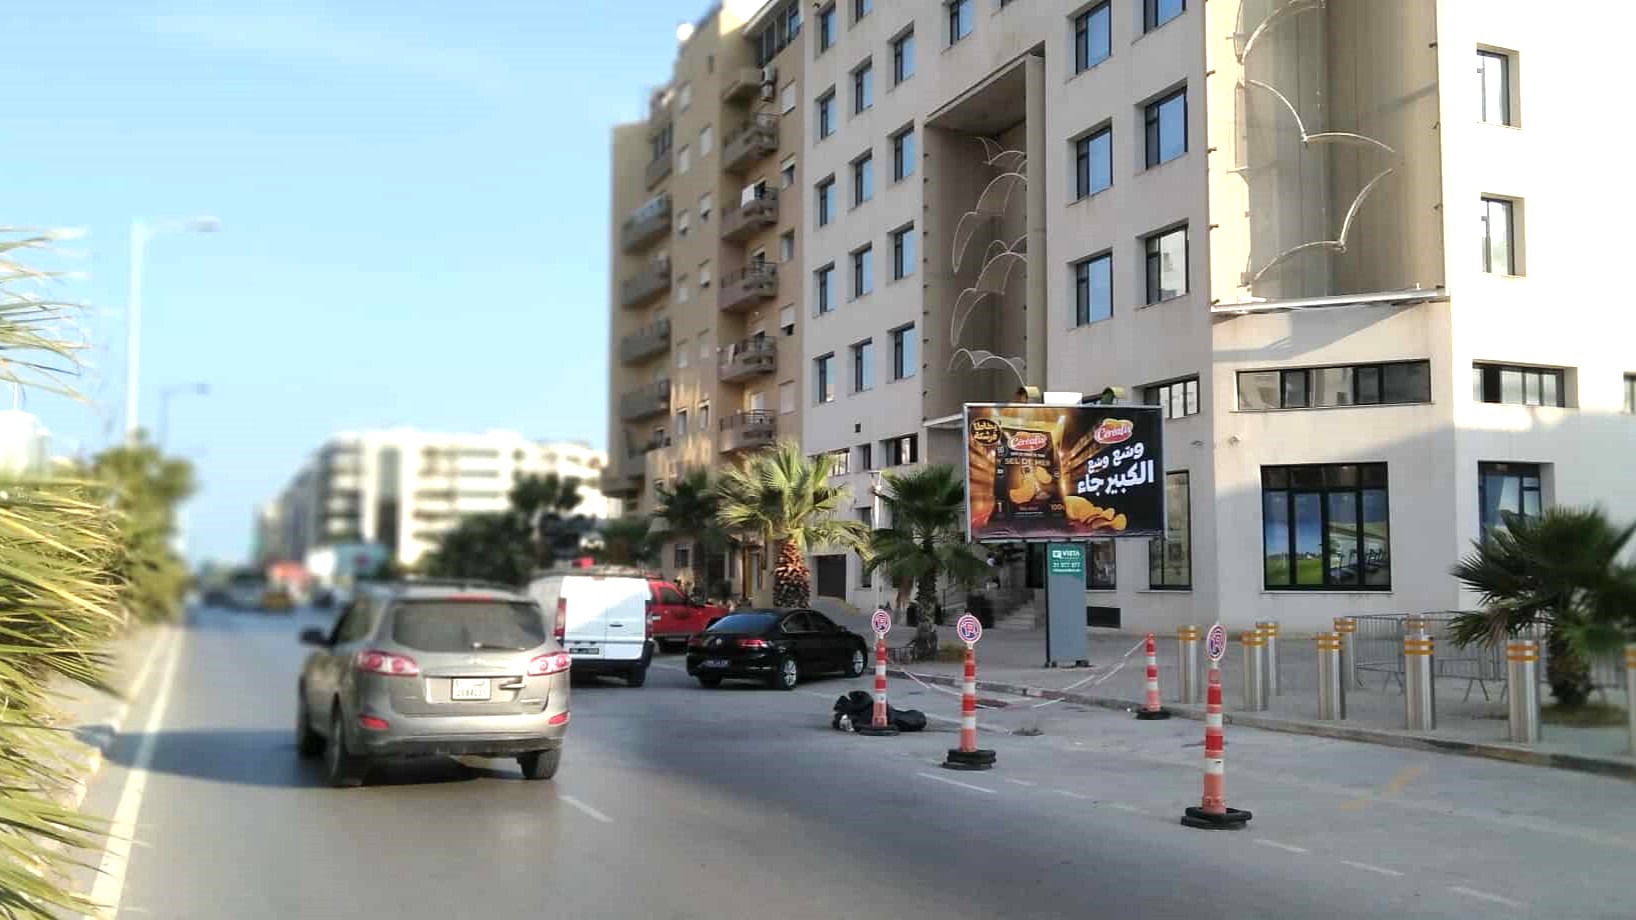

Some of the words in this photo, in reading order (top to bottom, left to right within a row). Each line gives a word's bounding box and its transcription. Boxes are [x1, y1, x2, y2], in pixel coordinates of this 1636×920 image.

[1005, 457, 1020, 465] SEL
[1077, 473, 1104, 496] جاء
[1105, 459, 1154, 495] الكبير
